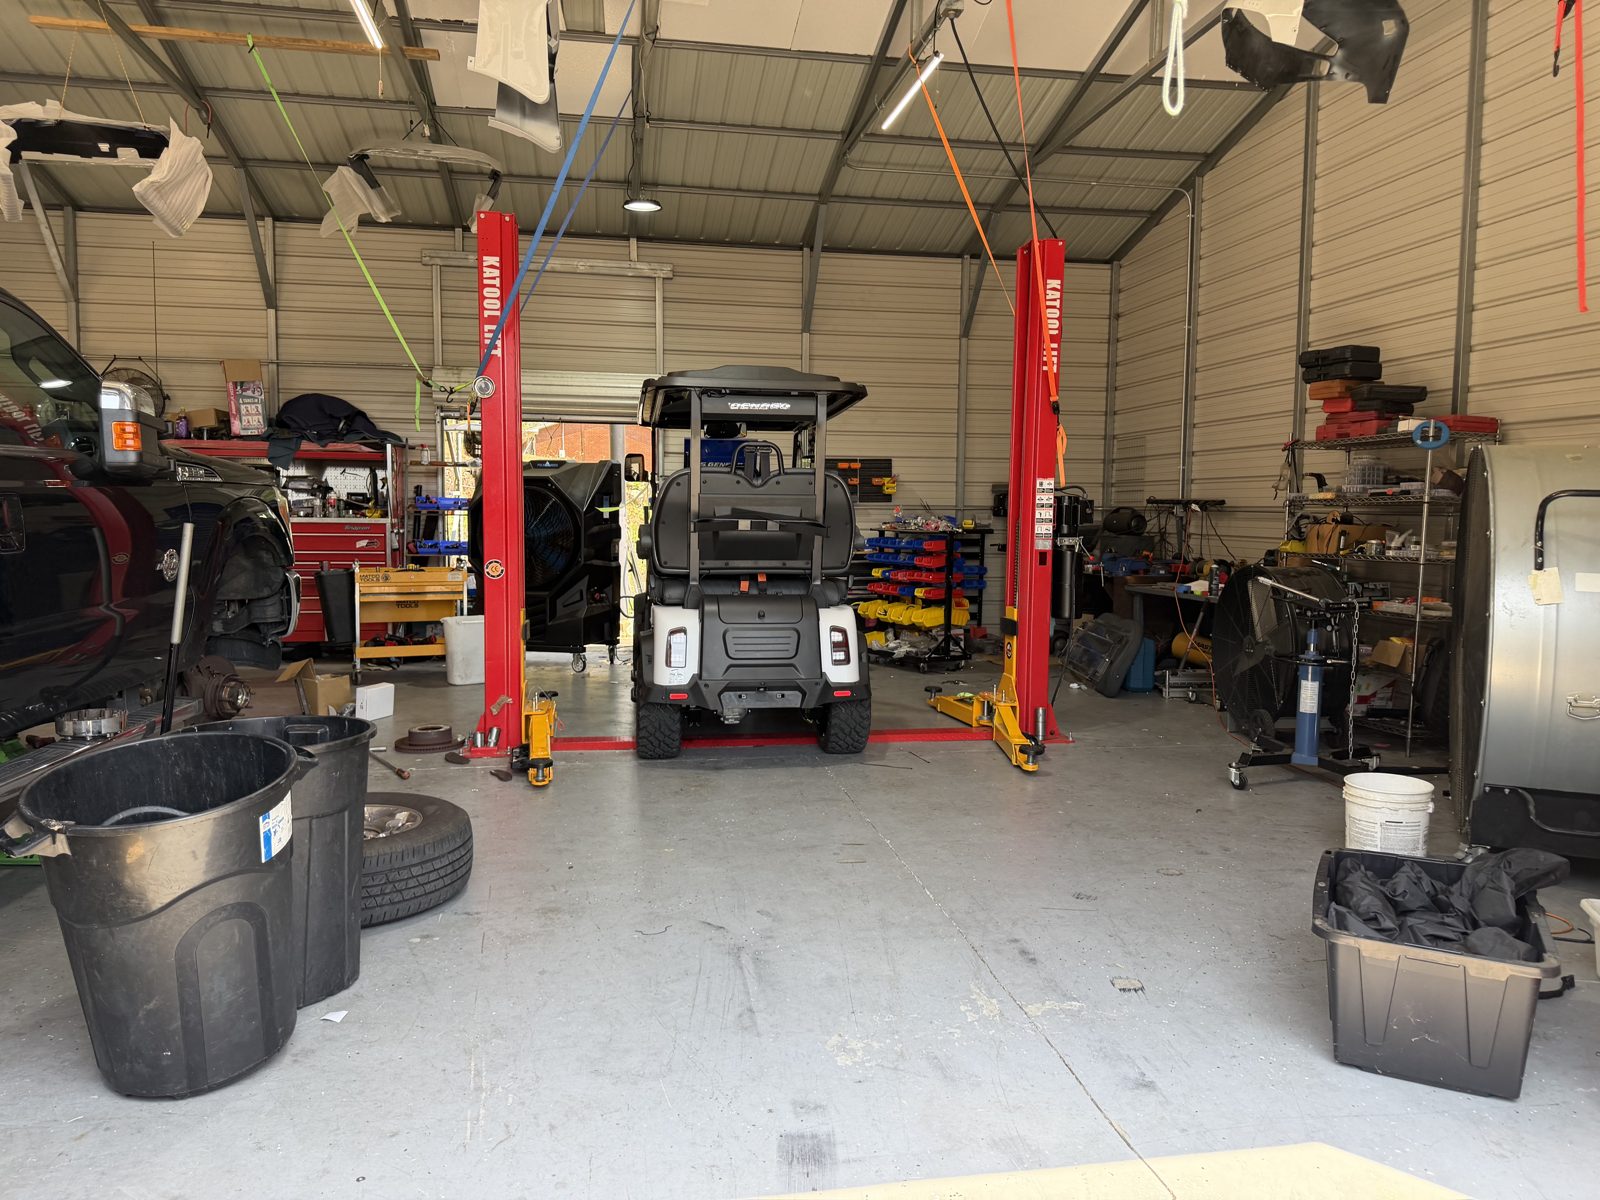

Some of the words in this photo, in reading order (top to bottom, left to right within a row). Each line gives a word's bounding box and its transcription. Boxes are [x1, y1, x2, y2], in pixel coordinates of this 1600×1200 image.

[483, 256, 501, 318] KATOOL
[1046, 279, 1061, 335] KATOOL
[484, 324, 502, 357] LIFT
